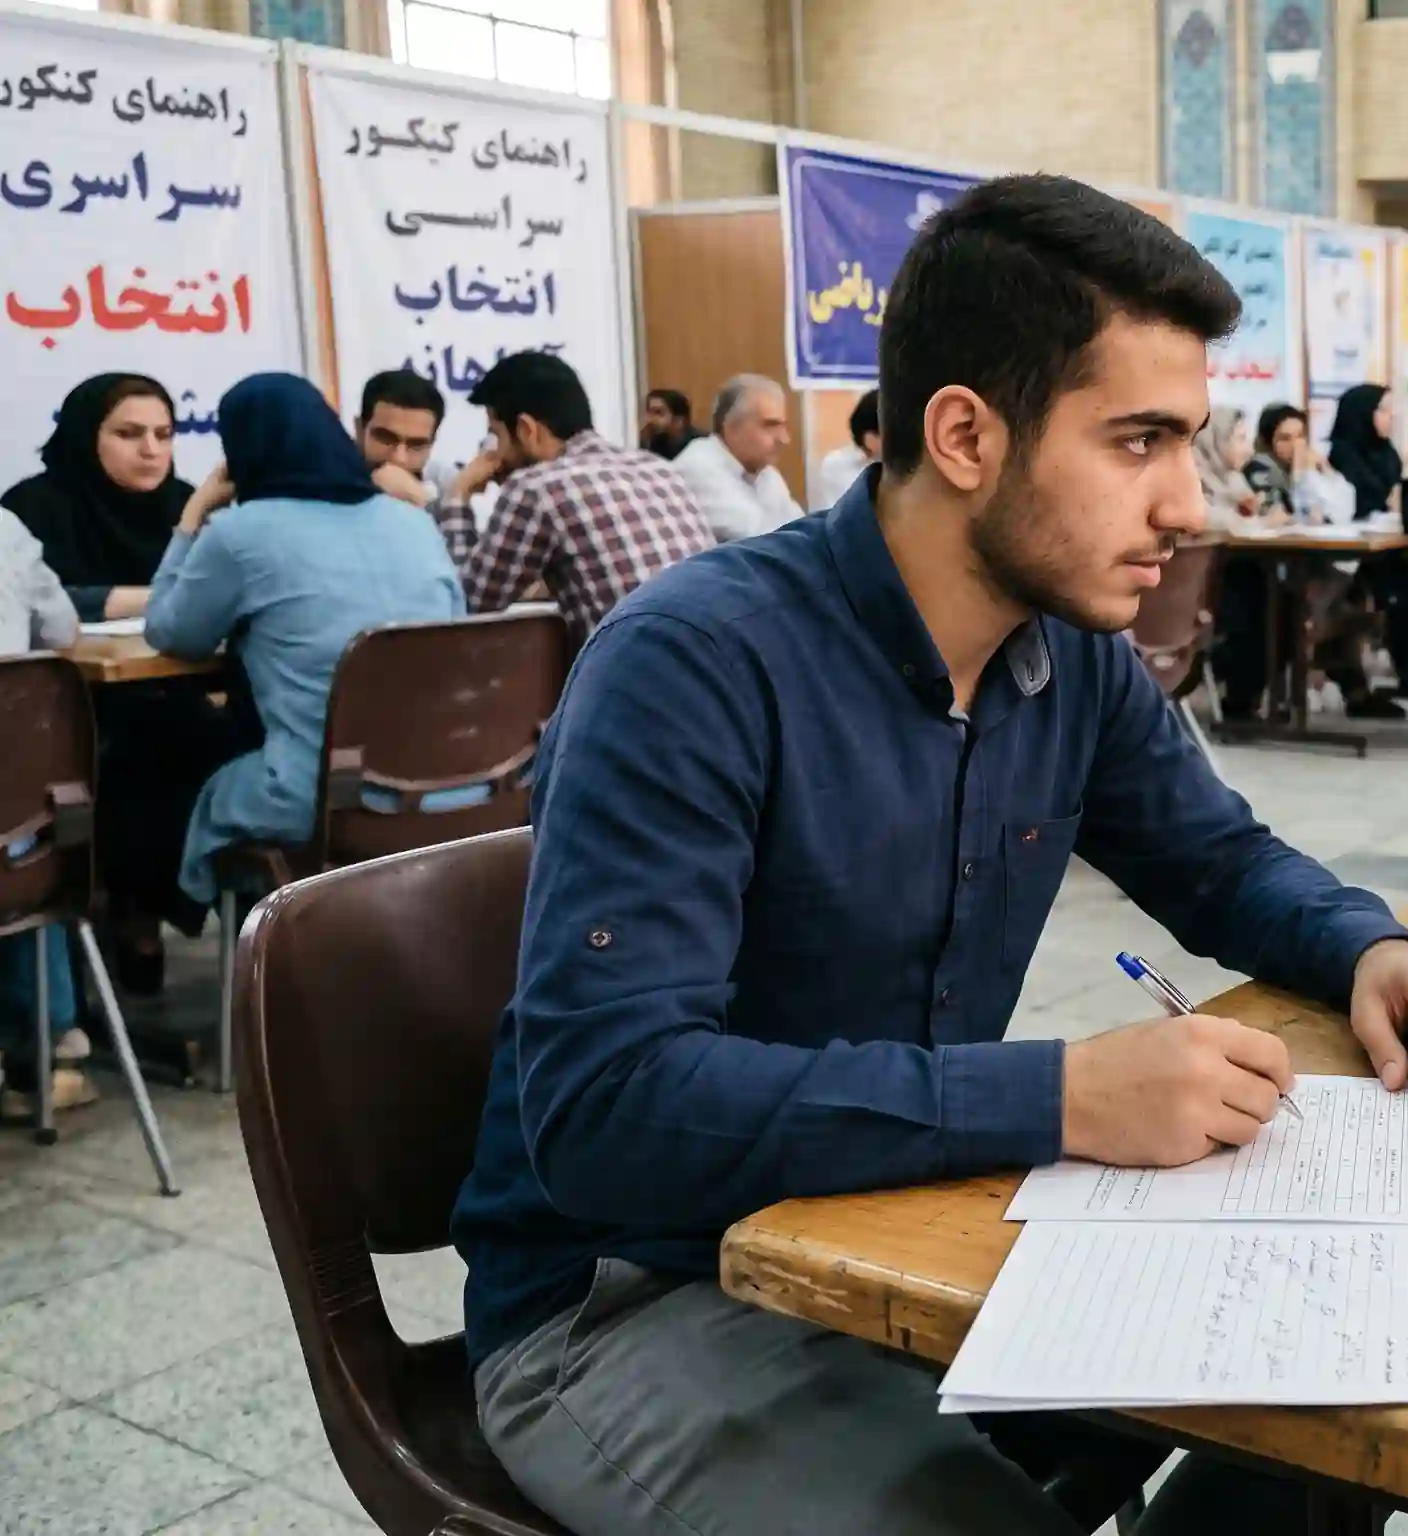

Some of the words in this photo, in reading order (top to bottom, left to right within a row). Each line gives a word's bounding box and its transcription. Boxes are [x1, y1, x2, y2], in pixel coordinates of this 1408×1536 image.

[0, 63, 98, 110] کنکور
[112, 76, 247, 137] راهنمای
[0, 150, 242, 222] سراسری
[472, 128, 588, 184] راهنمای
[6, 263, 252, 350] انتخاب
[394, 264, 556, 326] انتخاب
